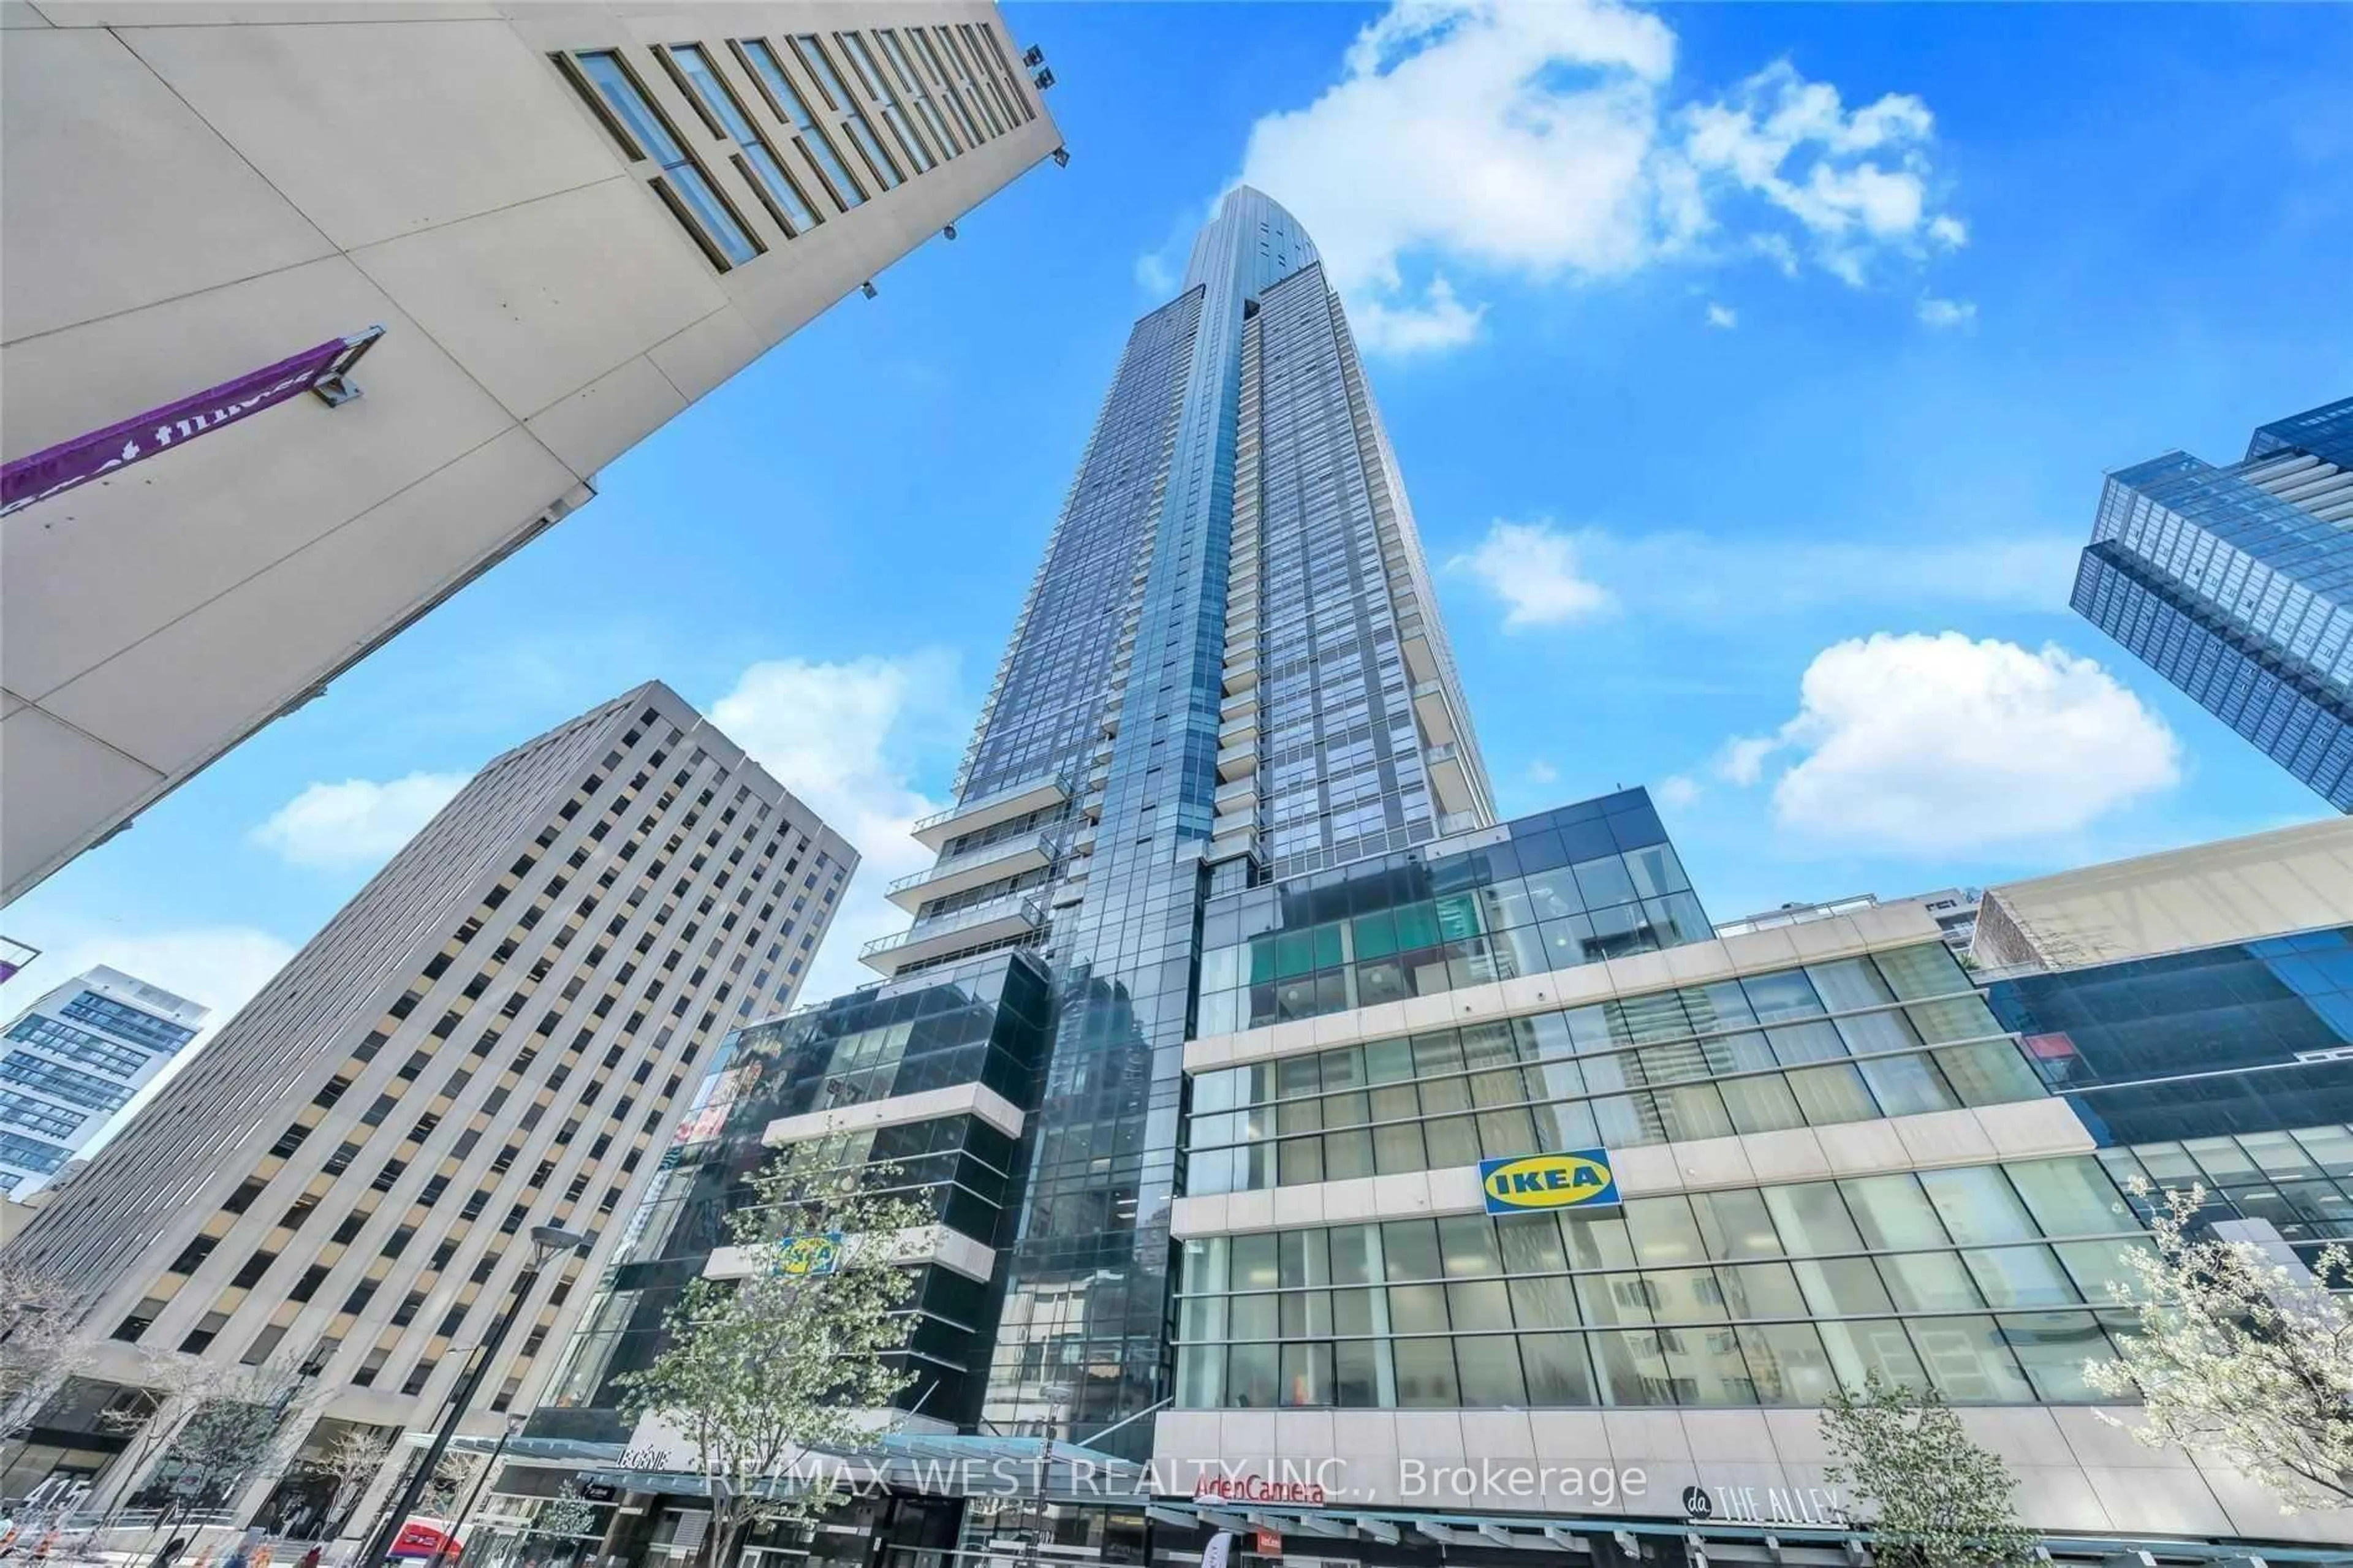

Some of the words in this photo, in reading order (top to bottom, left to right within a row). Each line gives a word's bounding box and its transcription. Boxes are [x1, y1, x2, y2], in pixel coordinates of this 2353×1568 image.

[1496, 1166, 1603, 1194] IKEA
[23, 1477, 93, 1517] 415
[1194, 1472, 1324, 1503] AdenCamera
[1714, 1487, 1765, 1521] THE
[1768, 1487, 1846, 1524] ALLEY
